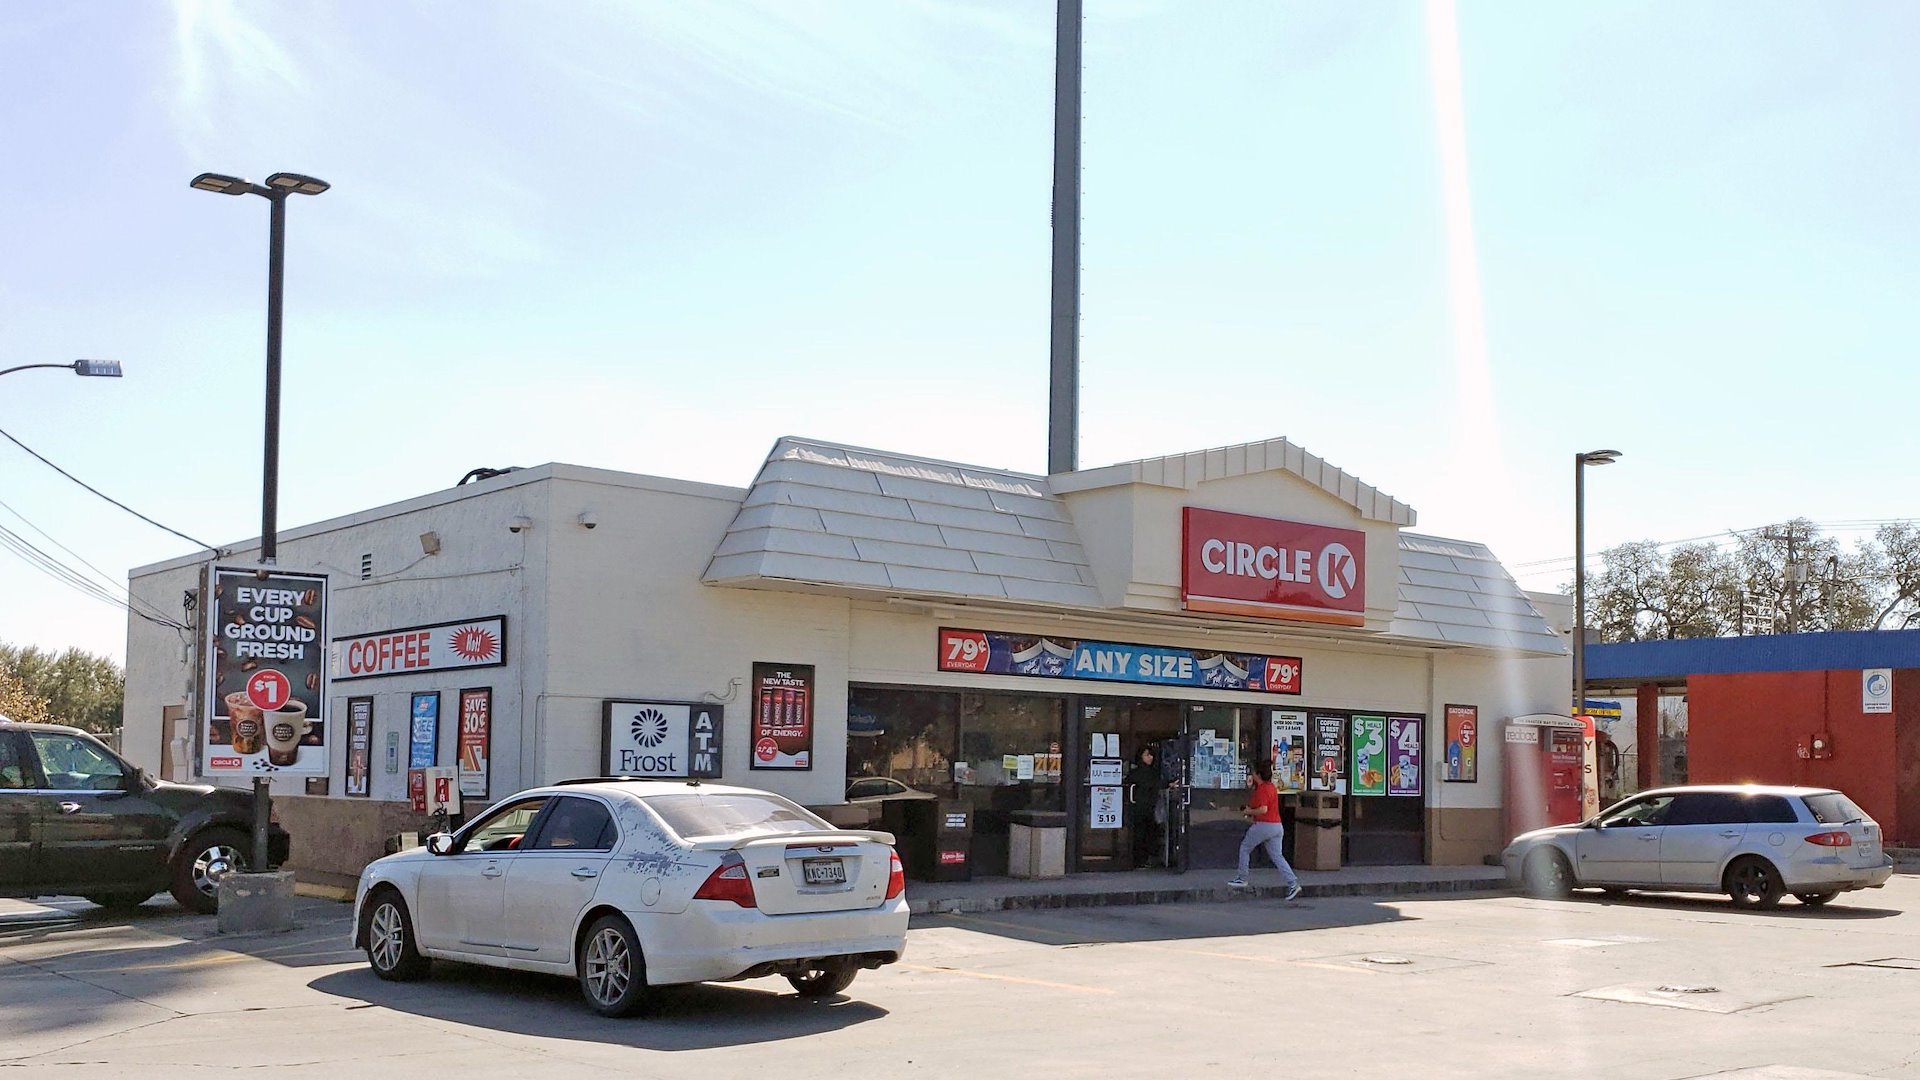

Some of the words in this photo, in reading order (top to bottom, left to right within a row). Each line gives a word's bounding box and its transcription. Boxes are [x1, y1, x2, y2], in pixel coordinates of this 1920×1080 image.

[1201, 538, 1311, 584] CIRCLE
[1320, 544, 1356, 598] K
[237, 586, 305, 606] EVERY
[249, 606, 294, 624] CUP
[224, 623, 316, 642] GROUND
[236, 641, 304, 660] FRESH
[348, 632, 431, 674] COFFEE
[947, 637, 987, 661] 79¢
[1075, 648, 1131, 675] ANY
[1138, 653, 1194, 679] SIZE
[1270, 663, 1299, 684] 79¢
[254, 679, 278, 703] $1
[464, 699, 487, 712] SAVE
[464, 712, 486, 733] 30¢
[694, 711, 713, 772] ATM
[619, 749, 677, 772] Frost
